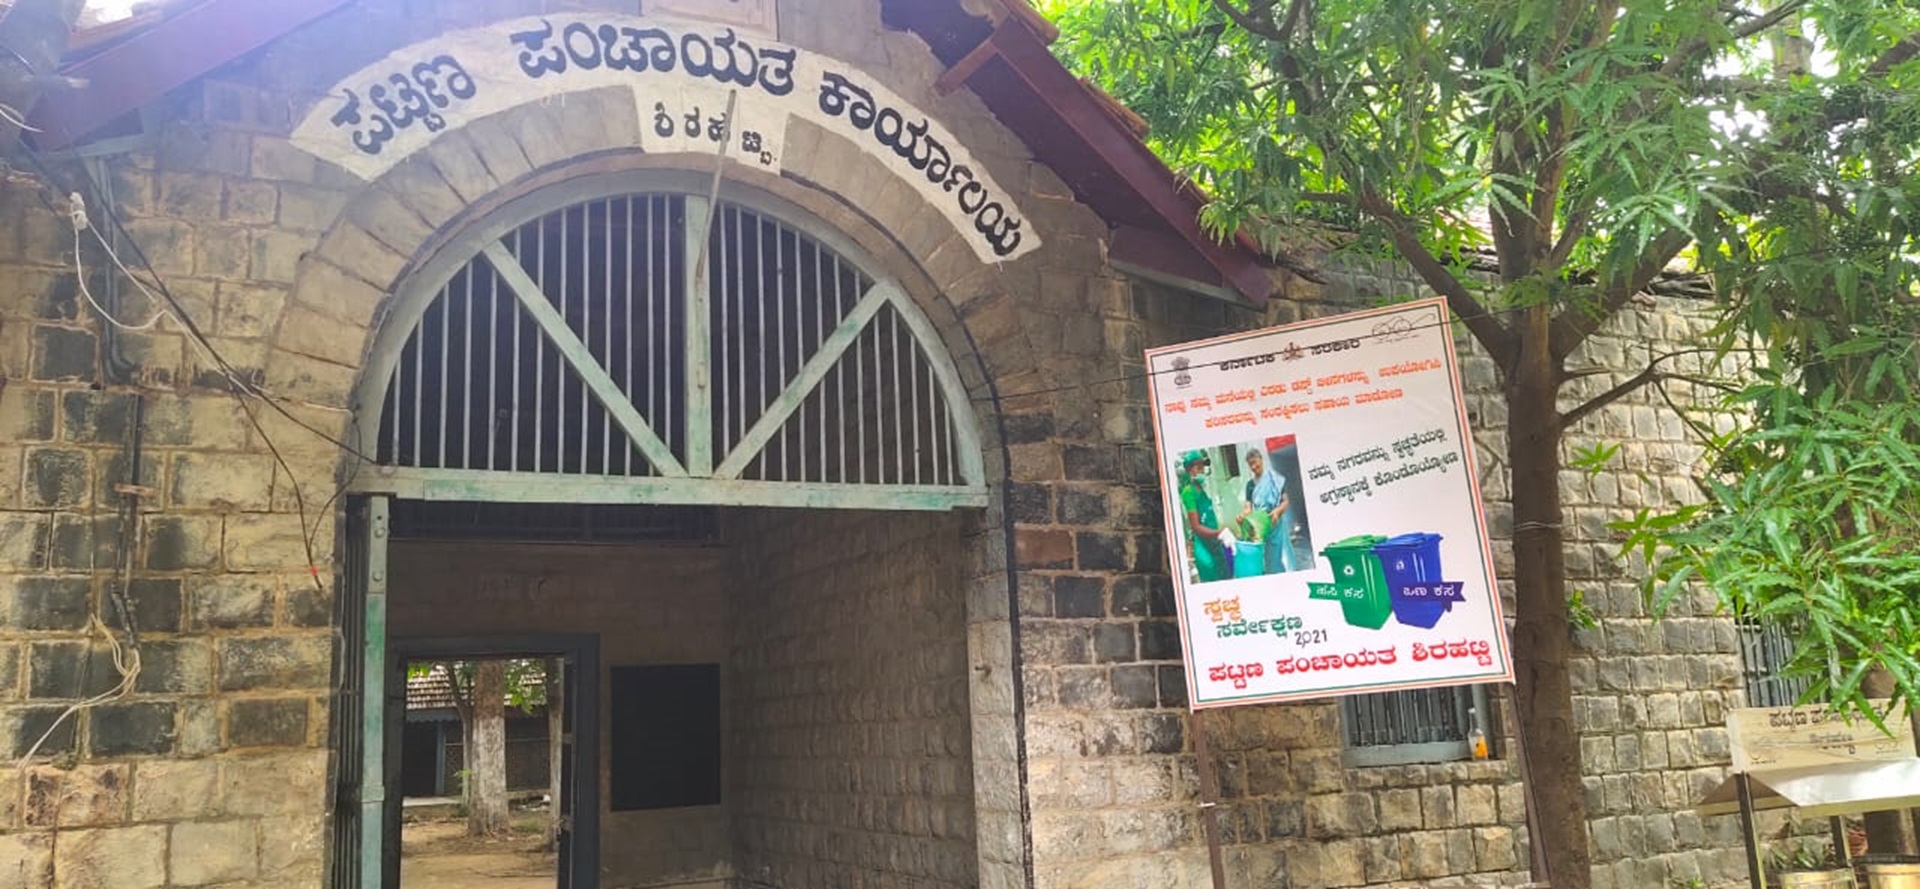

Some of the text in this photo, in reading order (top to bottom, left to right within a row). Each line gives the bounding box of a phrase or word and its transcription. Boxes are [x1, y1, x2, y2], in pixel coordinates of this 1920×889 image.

[331, 19, 1021, 256] ಪಟ್ಟಣ ಪಂಚಾಯತ ಕಾರ್ಯಾಲಯ
[1308, 463, 1336, 480] ನಮ್ಮ
[1336, 445, 1391, 472] ನಗರವನ್ನು
[1316, 586, 1365, 599] ಹಸಿ ಕಸ
[1403, 585, 1455, 597] ಒಣ ಕಸ
[1294, 628, 1328, 648] 2021
[1208, 638, 1493, 690] ಪಟ್ಟಣ ಪಂಚಾಯತ ಶಿರಹಟ್ಟಿ
